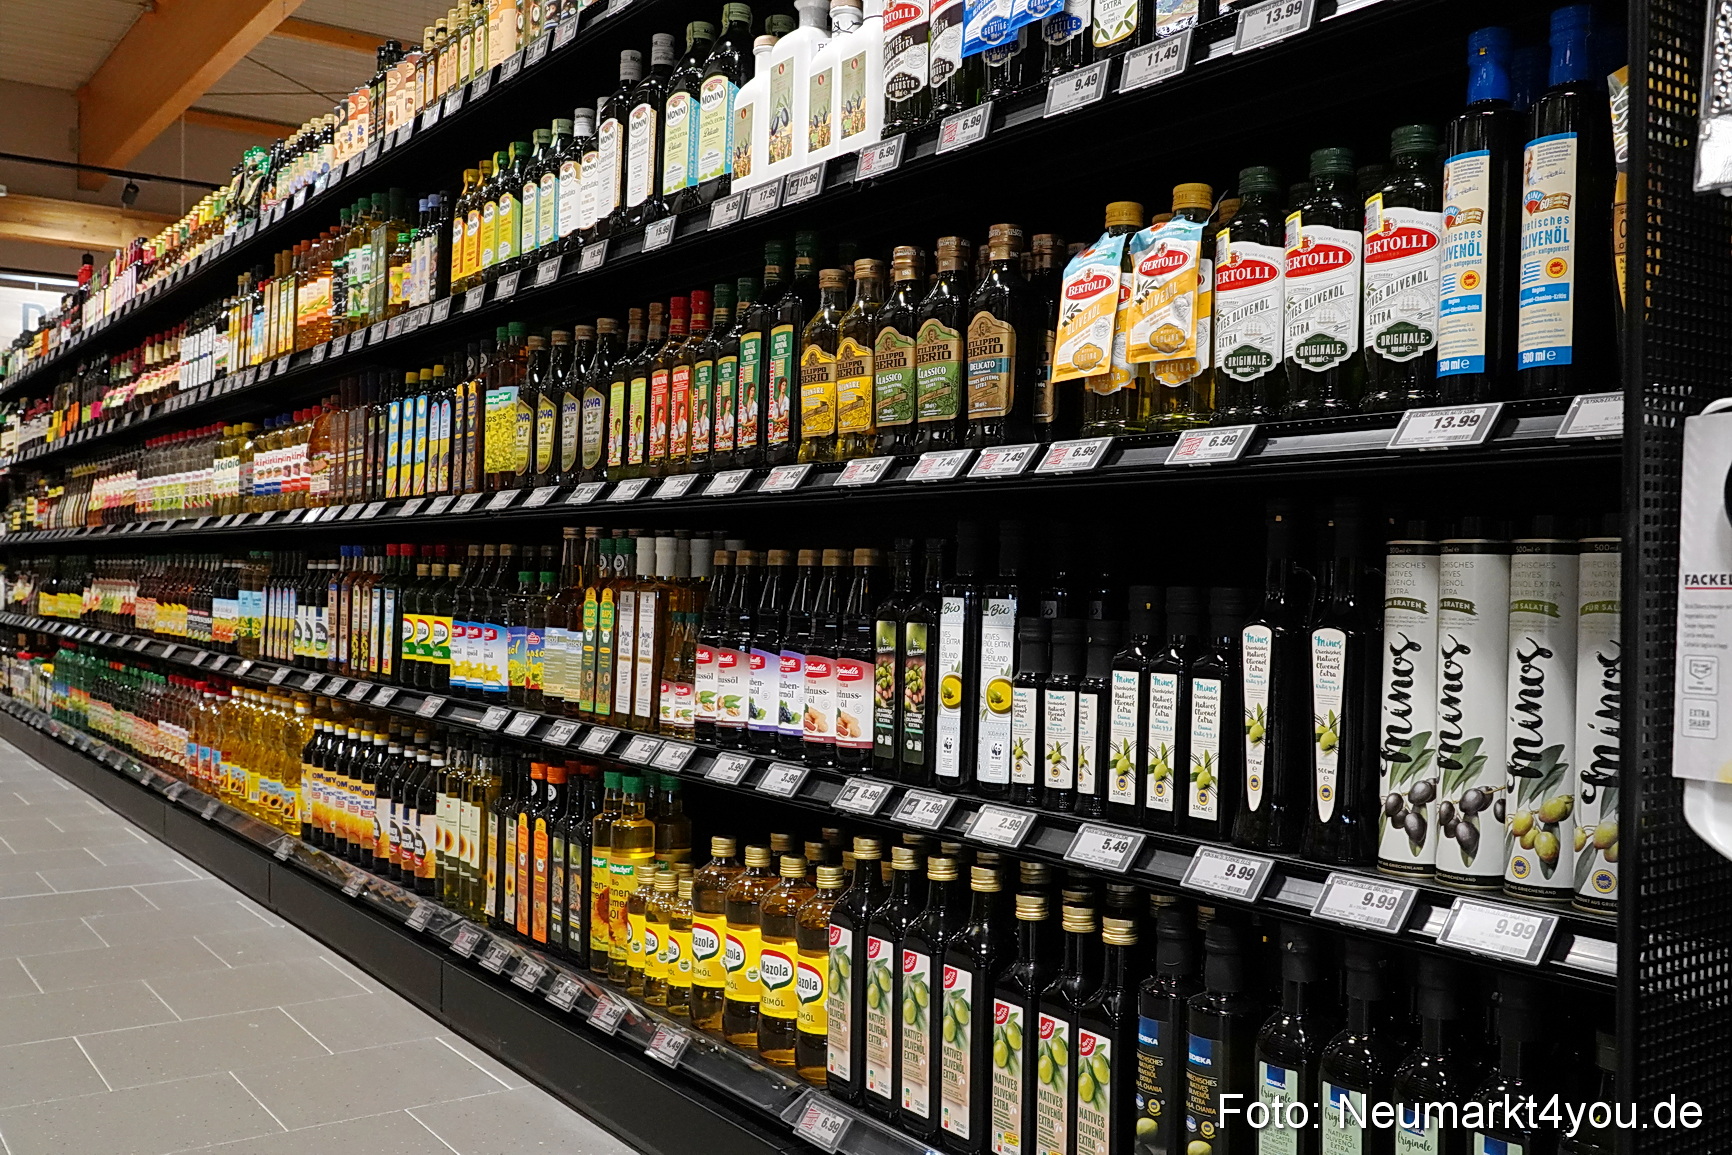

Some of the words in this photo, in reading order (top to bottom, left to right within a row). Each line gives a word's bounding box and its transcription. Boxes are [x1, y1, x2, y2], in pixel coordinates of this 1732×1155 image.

[1266, 2, 1302, 25] 13.99
[1147, 45, 1179, 67] 11.49
[1075, 73, 1098, 91] 9.49
[702, 90, 724, 105] MONINI
[667, 106, 686, 120] MONINI
[962, 115, 981, 131] 6.99
[879, 143, 896, 159] 6.99
[799, 173, 818, 188] 10.99
[759, 187, 777, 202] 17.99
[725, 200, 739, 213] 9.99
[1365, 233, 1428, 255] ERTOLLI
[1141, 255, 1184, 273] BERTOLLI
[1217, 266, 1270, 284] ERTOLLI
[1067, 278, 1107, 297] BERTOLLI
[1369, 309, 1392, 326] EXTRA
[1289, 322, 1310, 337] EXTRA
[968, 337, 1000, 348] FILIPPO
[1218, 333, 1238, 349] EXTRA
[1380, 332, 1426, 345] ORIGINALE
[875, 351, 904, 361] FILIPPO
[917, 344, 949, 355] FILIPPO
[917, 350, 952, 363] BERIO
[968, 343, 1004, 358] BERIO
[1300, 344, 1342, 356] ORIGINALE
[875, 358, 907, 370] BERIO
[1228, 354, 1267, 367] ORIGINALE
[1522, 351, 1534, 364] 500
[1535, 350, 1546, 362] ml
[969, 361, 996, 371] DELICATO
[1433, 415, 1480, 430] 13.99
[1208, 434, 1238, 448] 6.99
[1001, 452, 1025, 463] 7.49
[1072, 446, 1097, 457] 6.99
[862, 463, 882, 473] 7.49
[938, 457, 960, 467] 7.49
[784, 471, 801, 479] 7.49
[943, 602, 961, 615] Bio
[990, 604, 1010, 617] Bio
[1394, 600, 1422, 609] BRATEN
[1443, 601, 1471, 610] BRATEN
[1520, 603, 1549, 612] SALATE
[1585, 604, 1599, 612] FÜR
[1246, 651, 1267, 659] Natives
[1316, 655, 1340, 663] Natives
[1249, 665, 1264, 673] Extra
[1319, 670, 1337, 678] Extra
[808, 696, 815, 704] öl
[840, 700, 847, 708] öl
[1117, 706, 1132, 714] Extra
[1155, 709, 1170, 718] Extra
[1689, 708, 1710, 718] EXTRA
[1197, 716, 1213, 725] Extra
[1689, 718, 1711, 728] SHARP
[728, 760, 744, 772] 3.99
[780, 773, 798, 784] 3.99
[860, 787, 880, 801] 8.99
[921, 801, 943, 815] 7.99
[998, 817, 1022, 831] 2.99
[1102, 838, 1129, 854] 5.49
[1224, 863, 1256, 881] 9.99
[1517, 886, 1557, 896] GRIECHENLAND
[1361, 892, 1399, 911] 9.99
[1494, 918, 1536, 940] 9.99
[692, 968, 711, 977] EIMÖL
[761, 960, 789, 977] Mazola
[798, 976, 818, 991] azola
[868, 1012, 886, 1026] NATIVES
[868, 1034, 882, 1045] EXTRA
[904, 1028, 923, 1043] NATIVES
[666, 1037, 682, 1051] 4.49
[904, 1051, 919, 1062] EXTRA
[943, 1046, 963, 1062] NATIVES
[1188, 1052, 1212, 1065] EDEKA
[943, 1058, 965, 1074] OLIVENÖL
[943, 1070, 958, 1082] EXTRA
[994, 1072, 1018, 1091] NATIVES
[1266, 1078, 1286, 1089] EDEKA
[993, 1085, 1019, 1105] OLIVENÖL
[1038, 1088, 1063, 1109] NATIVES
[993, 1098, 1009, 1112] EXTRA
[1038, 1102, 1064, 1122] OLIVENÖL
[1195, 1103, 1217, 1115] CHANIA
[1038, 1115, 1054, 1129] EXTRA
[1079, 1107, 1105, 1128] NATIVES
[821, 1117, 840, 1134] 6.99
[1079, 1122, 1106, 1142] OLIVENÖL
[1078, 1134, 1096, 1150] EXTRA
[1327, 1128, 1353, 1142] NATIVES
[1397, 1131, 1433, 1152] Originale
[1330, 1140, 1350, 1153] EXTRA
